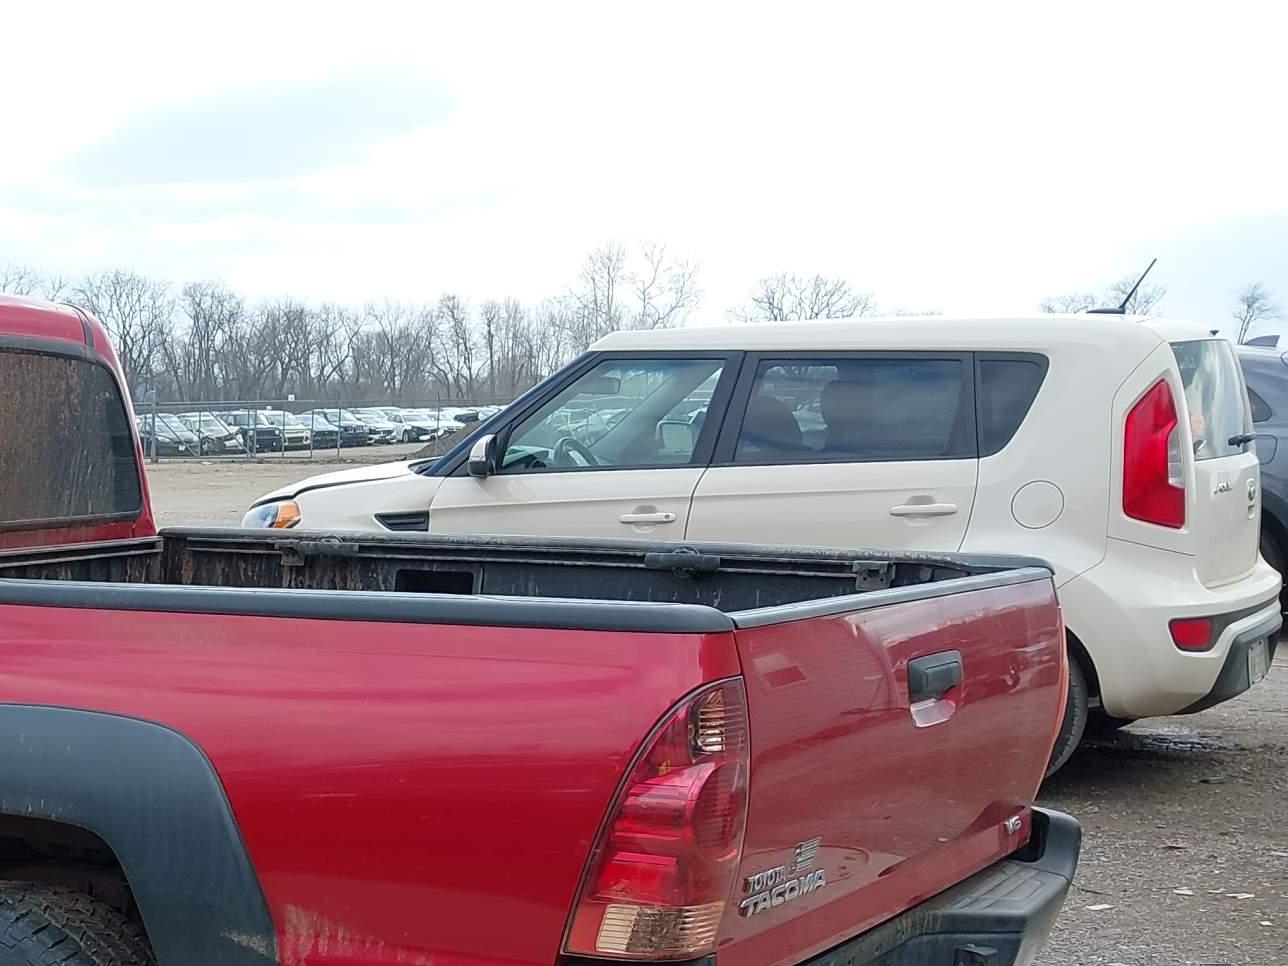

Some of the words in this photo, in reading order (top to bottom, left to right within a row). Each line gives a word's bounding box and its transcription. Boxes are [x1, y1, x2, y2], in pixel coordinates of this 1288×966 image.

[1002, 815, 1022, 834] V6
[738, 869, 826, 918] TACOMA
[745, 865, 786, 895] TOYOTA
